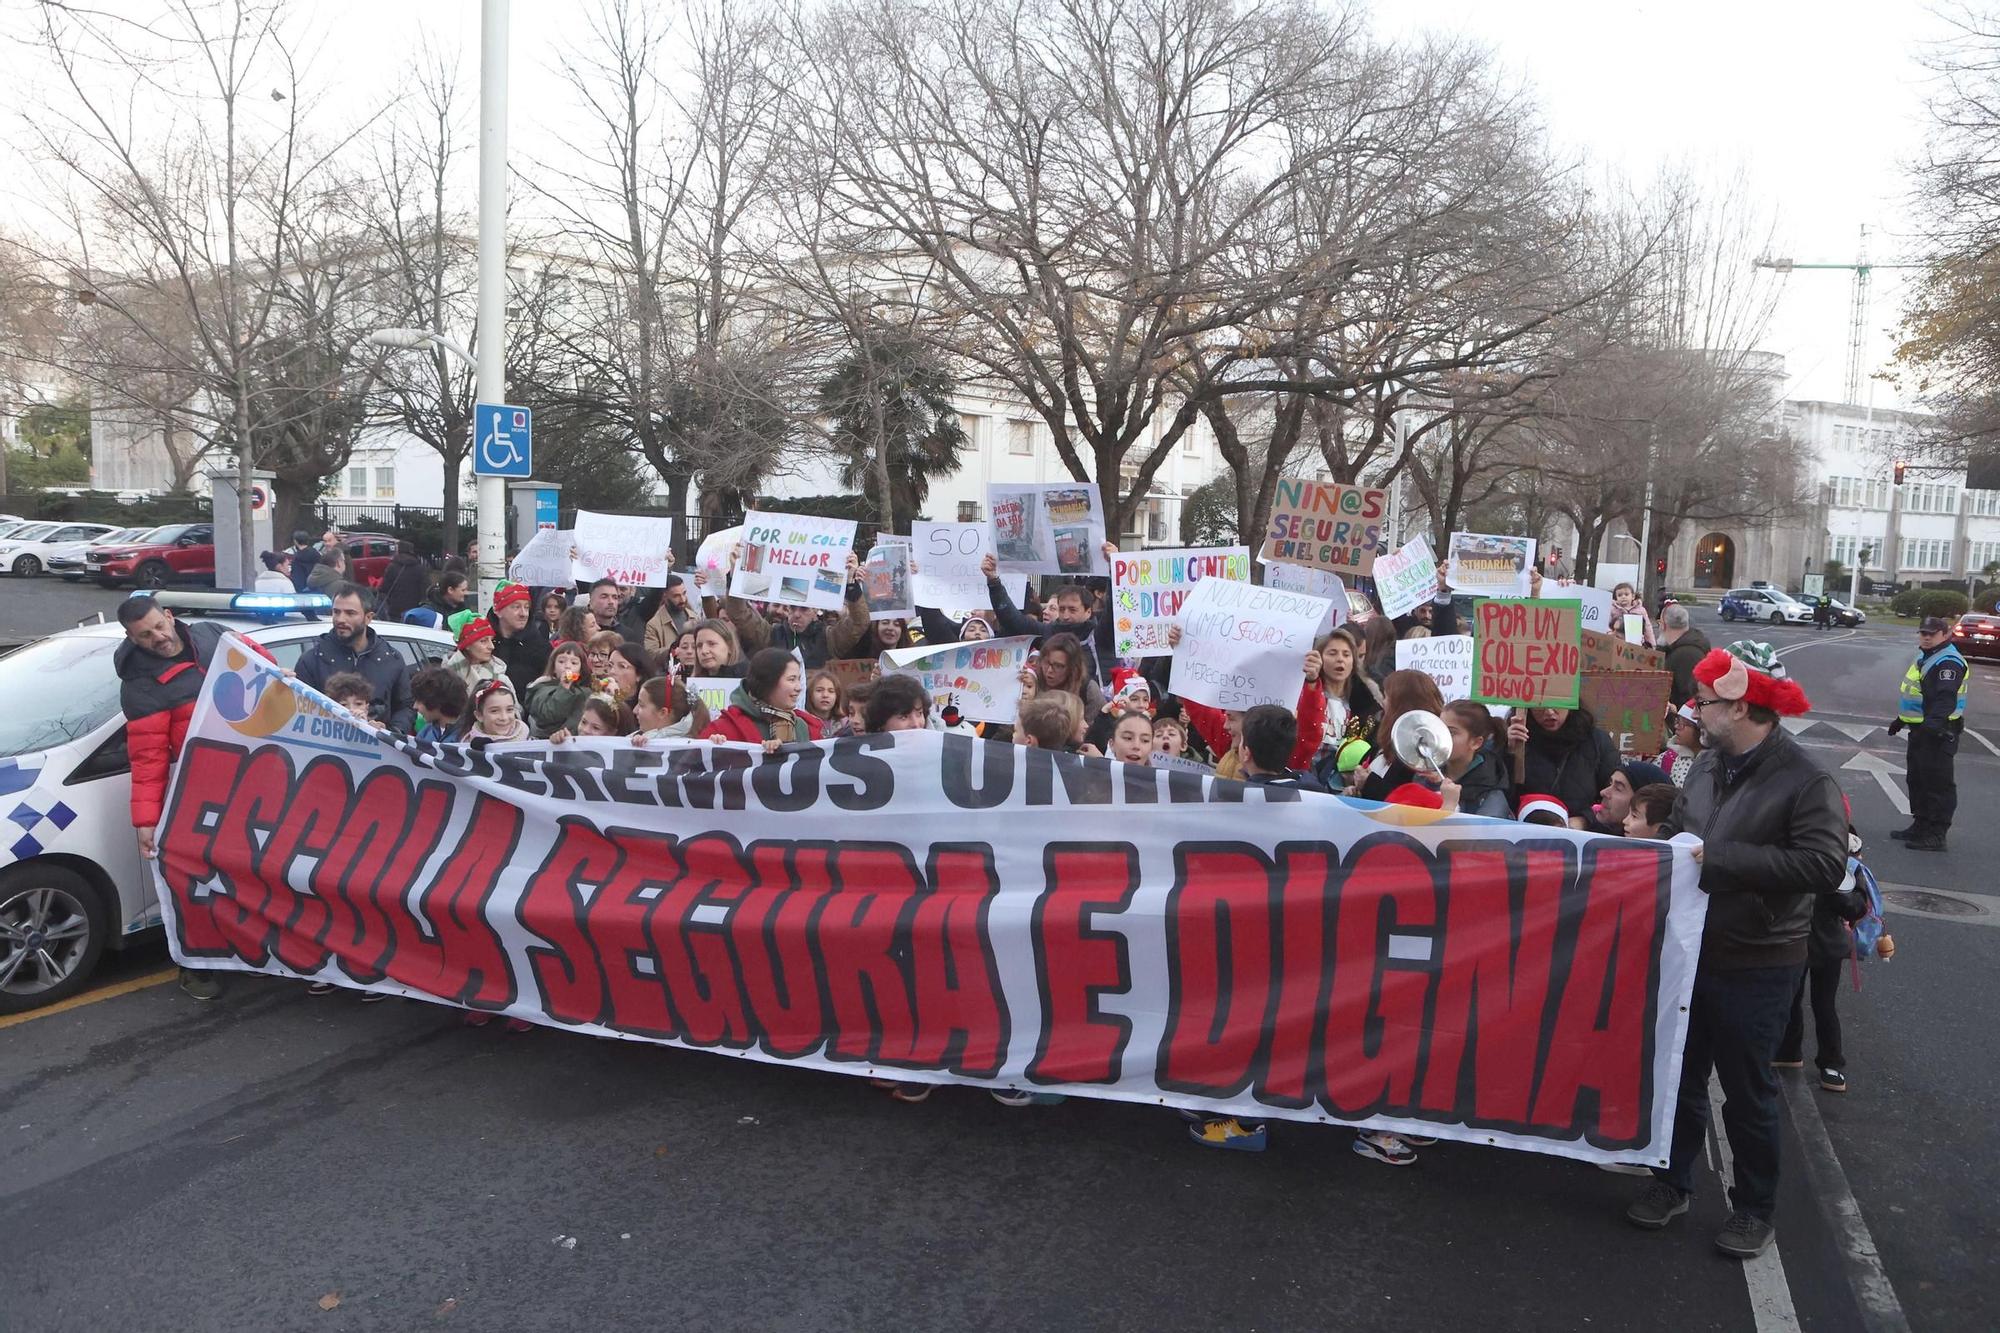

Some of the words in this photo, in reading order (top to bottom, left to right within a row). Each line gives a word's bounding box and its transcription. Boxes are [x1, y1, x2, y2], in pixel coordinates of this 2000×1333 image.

[750, 527, 781, 544] POR
[788, 532, 808, 545] UN
[811, 534, 849, 547] COLE
[1270, 513, 1380, 551] SEGUROS
[768, 548, 830, 568] MELLOR
[1273, 540, 1296, 558] EN
[1296, 542, 1313, 561] EL
[1318, 545, 1362, 567] COLE
[1115, 559, 1152, 586] POR
[1158, 557, 1185, 584] UN
[1187, 554, 1248, 582] CENTRO
[1134, 623, 1171, 649] SAU
[1534, 607, 1561, 641] UN
[1482, 639, 1579, 676] COLEXIO
[292, 714, 306, 733] A
[397, 732, 896, 813] UEREMOS
[158, 736, 527, 1011] ESCOLA
[514, 814, 1012, 1080] SEGURA
[1025, 840, 1142, 1086] E
[1155, 832, 1674, 1151] DIGNA
